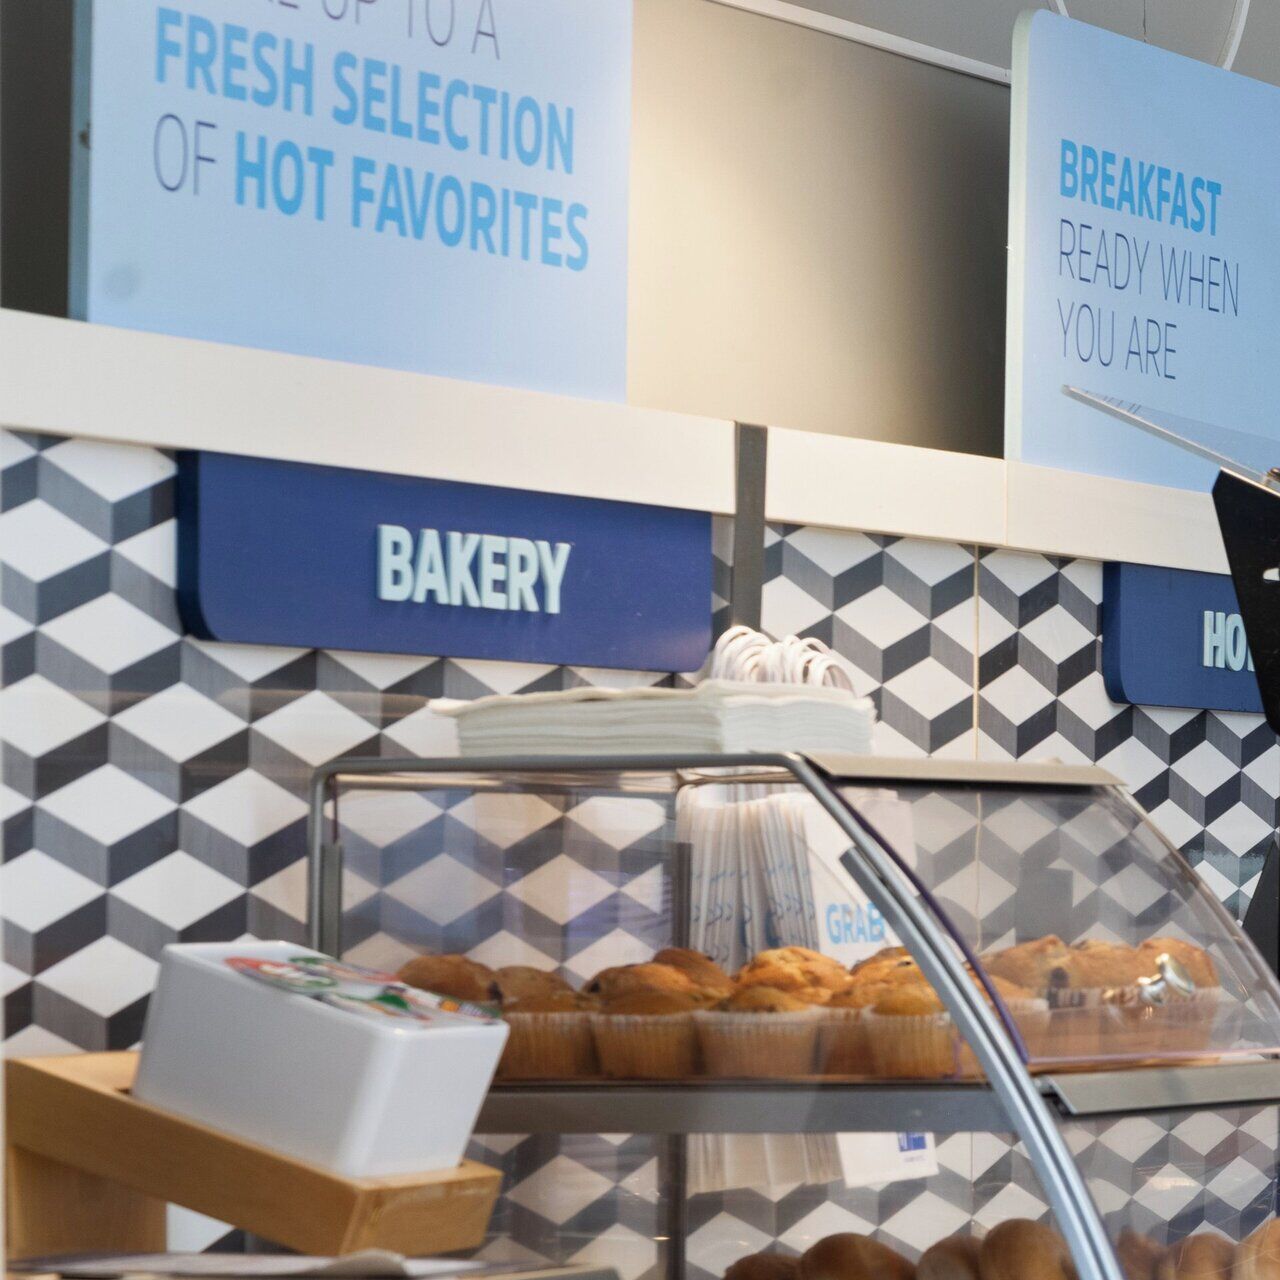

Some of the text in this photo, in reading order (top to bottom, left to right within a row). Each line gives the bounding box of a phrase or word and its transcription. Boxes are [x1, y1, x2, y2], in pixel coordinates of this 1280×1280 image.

[471, 0, 500, 60] A
[154, 6, 575, 175] FRESH SELECTION
[152, 113, 590, 273] OF HOT FAVORITES
[1060, 138, 1222, 237] BREAKFAST
[1059, 218, 1240, 317] READY WHEN
[1057, 298, 1178, 380] YOU ARE
[378, 524, 571, 614] BAKERY
[824, 900, 887, 945] GRAB
